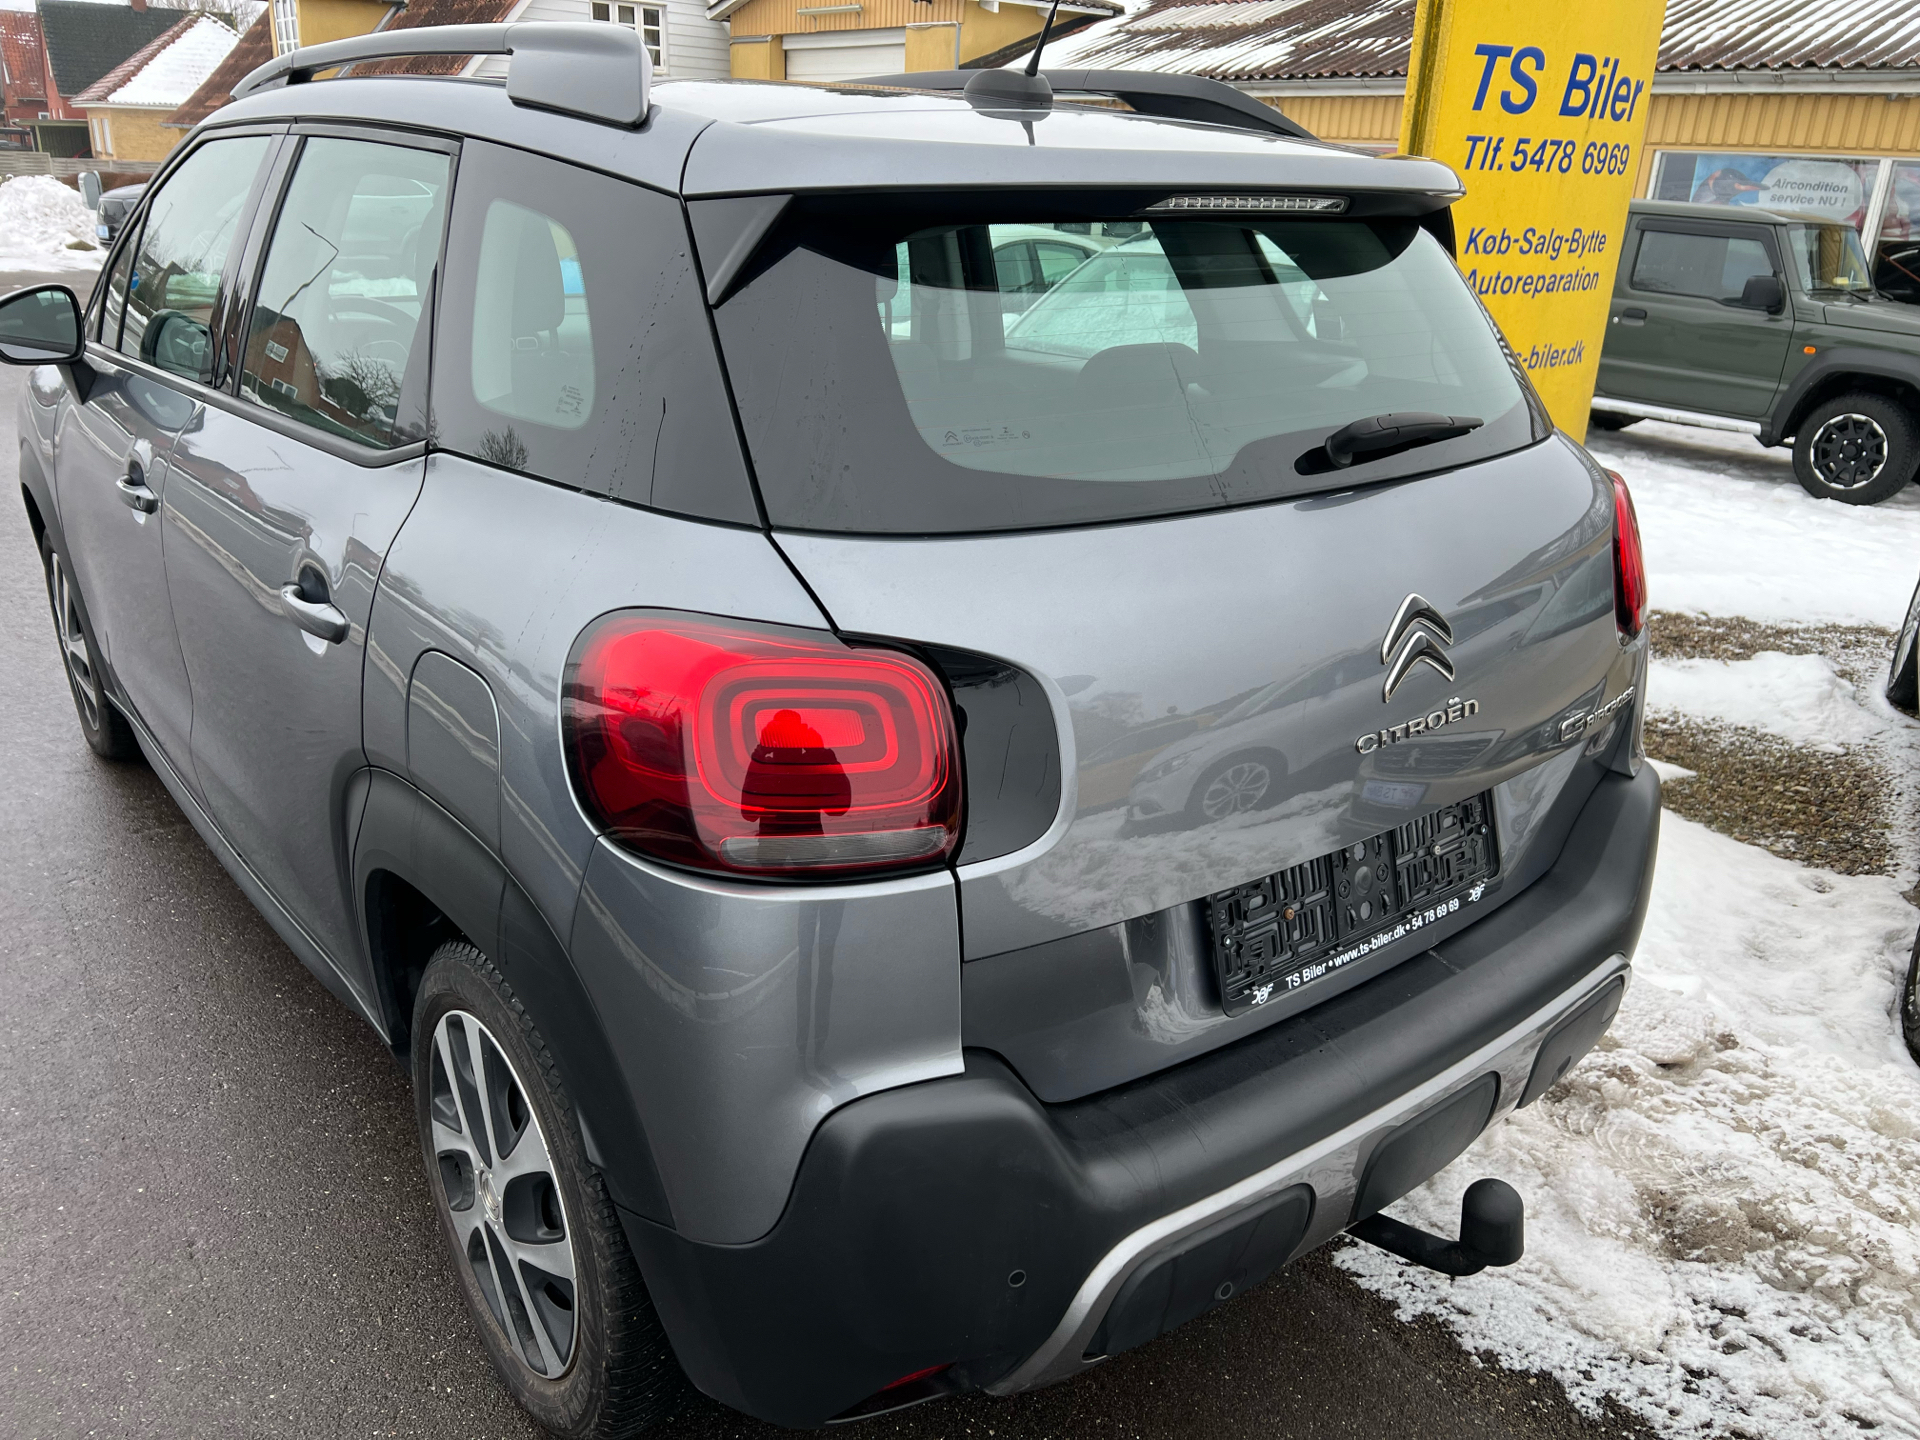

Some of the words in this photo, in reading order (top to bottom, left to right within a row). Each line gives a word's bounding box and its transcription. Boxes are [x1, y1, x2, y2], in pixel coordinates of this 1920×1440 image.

[1472, 43, 1546, 115] TS
[1558, 52, 1645, 122] Biler
[1464, 135, 1505, 171] Tlf.
[1510, 138, 1576, 174] 5478
[1582, 141, 1630, 176] 6969
[1769, 193, 1815, 205] service
[1818, 195, 1838, 206] NU
[1771, 178, 1849, 194] Aircondition
[1464, 227, 1607, 261] Køb-Salg-Bytte
[1467, 266, 1600, 299] Autoreparation
[1285, 972, 1301, 990] TS
[1302, 962, 1327, 982] Biler
[1333, 924, 1406, 967] www.ts-biler.dk
[1411, 914, 1424, 930] 54
[1424, 909, 1436, 924] 78
[1436, 903, 1448, 918] 69
[1448, 897, 1460, 912] 69
